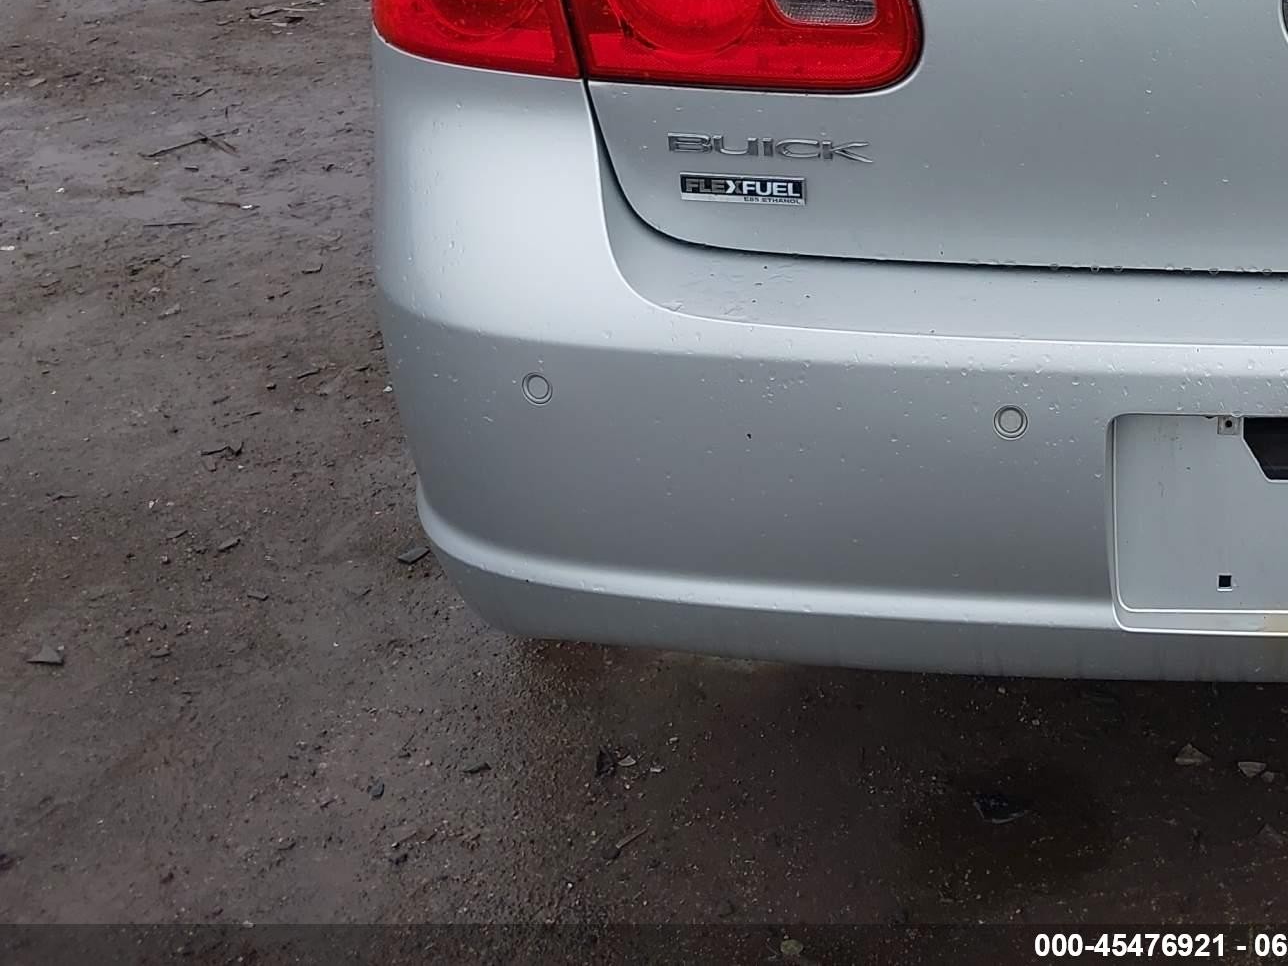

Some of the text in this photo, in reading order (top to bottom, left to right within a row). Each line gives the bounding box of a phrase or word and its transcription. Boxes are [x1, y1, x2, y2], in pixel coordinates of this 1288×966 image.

[668, 132, 873, 163] BUICK
[685, 178, 801, 197] FLEXFUEL
[762, 197, 802, 205] ETHANOL
